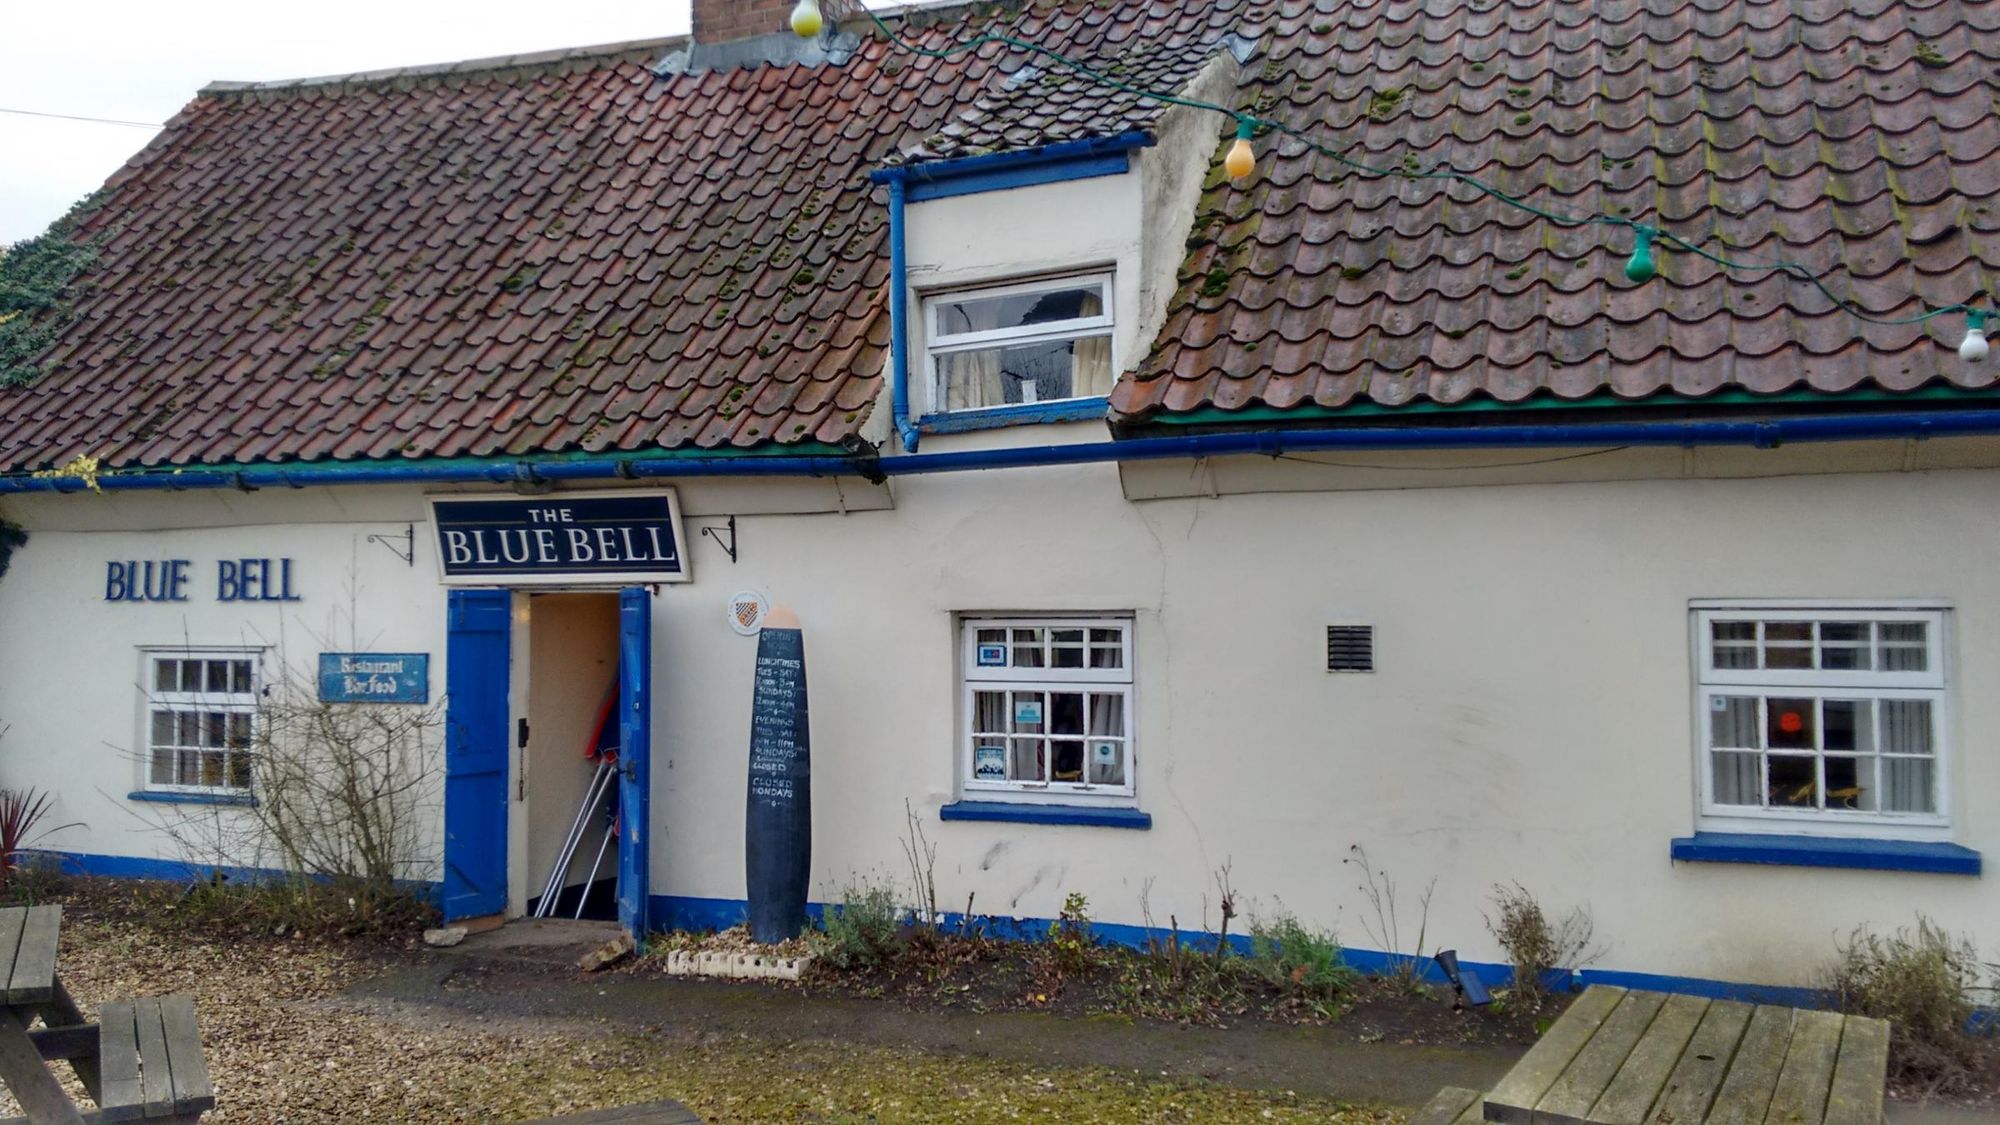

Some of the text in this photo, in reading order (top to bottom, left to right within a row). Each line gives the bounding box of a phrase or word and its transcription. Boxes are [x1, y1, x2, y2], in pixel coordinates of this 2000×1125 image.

[528, 508, 573, 523] THE
[443, 526, 675, 564] BLUE BELL
[104, 557, 304, 602] BLUE BELL
[341, 656, 403, 673] Restaurant
[758, 656, 801, 669] LUNCHTIMES
[752, 777, 792, 788] CLOSED
